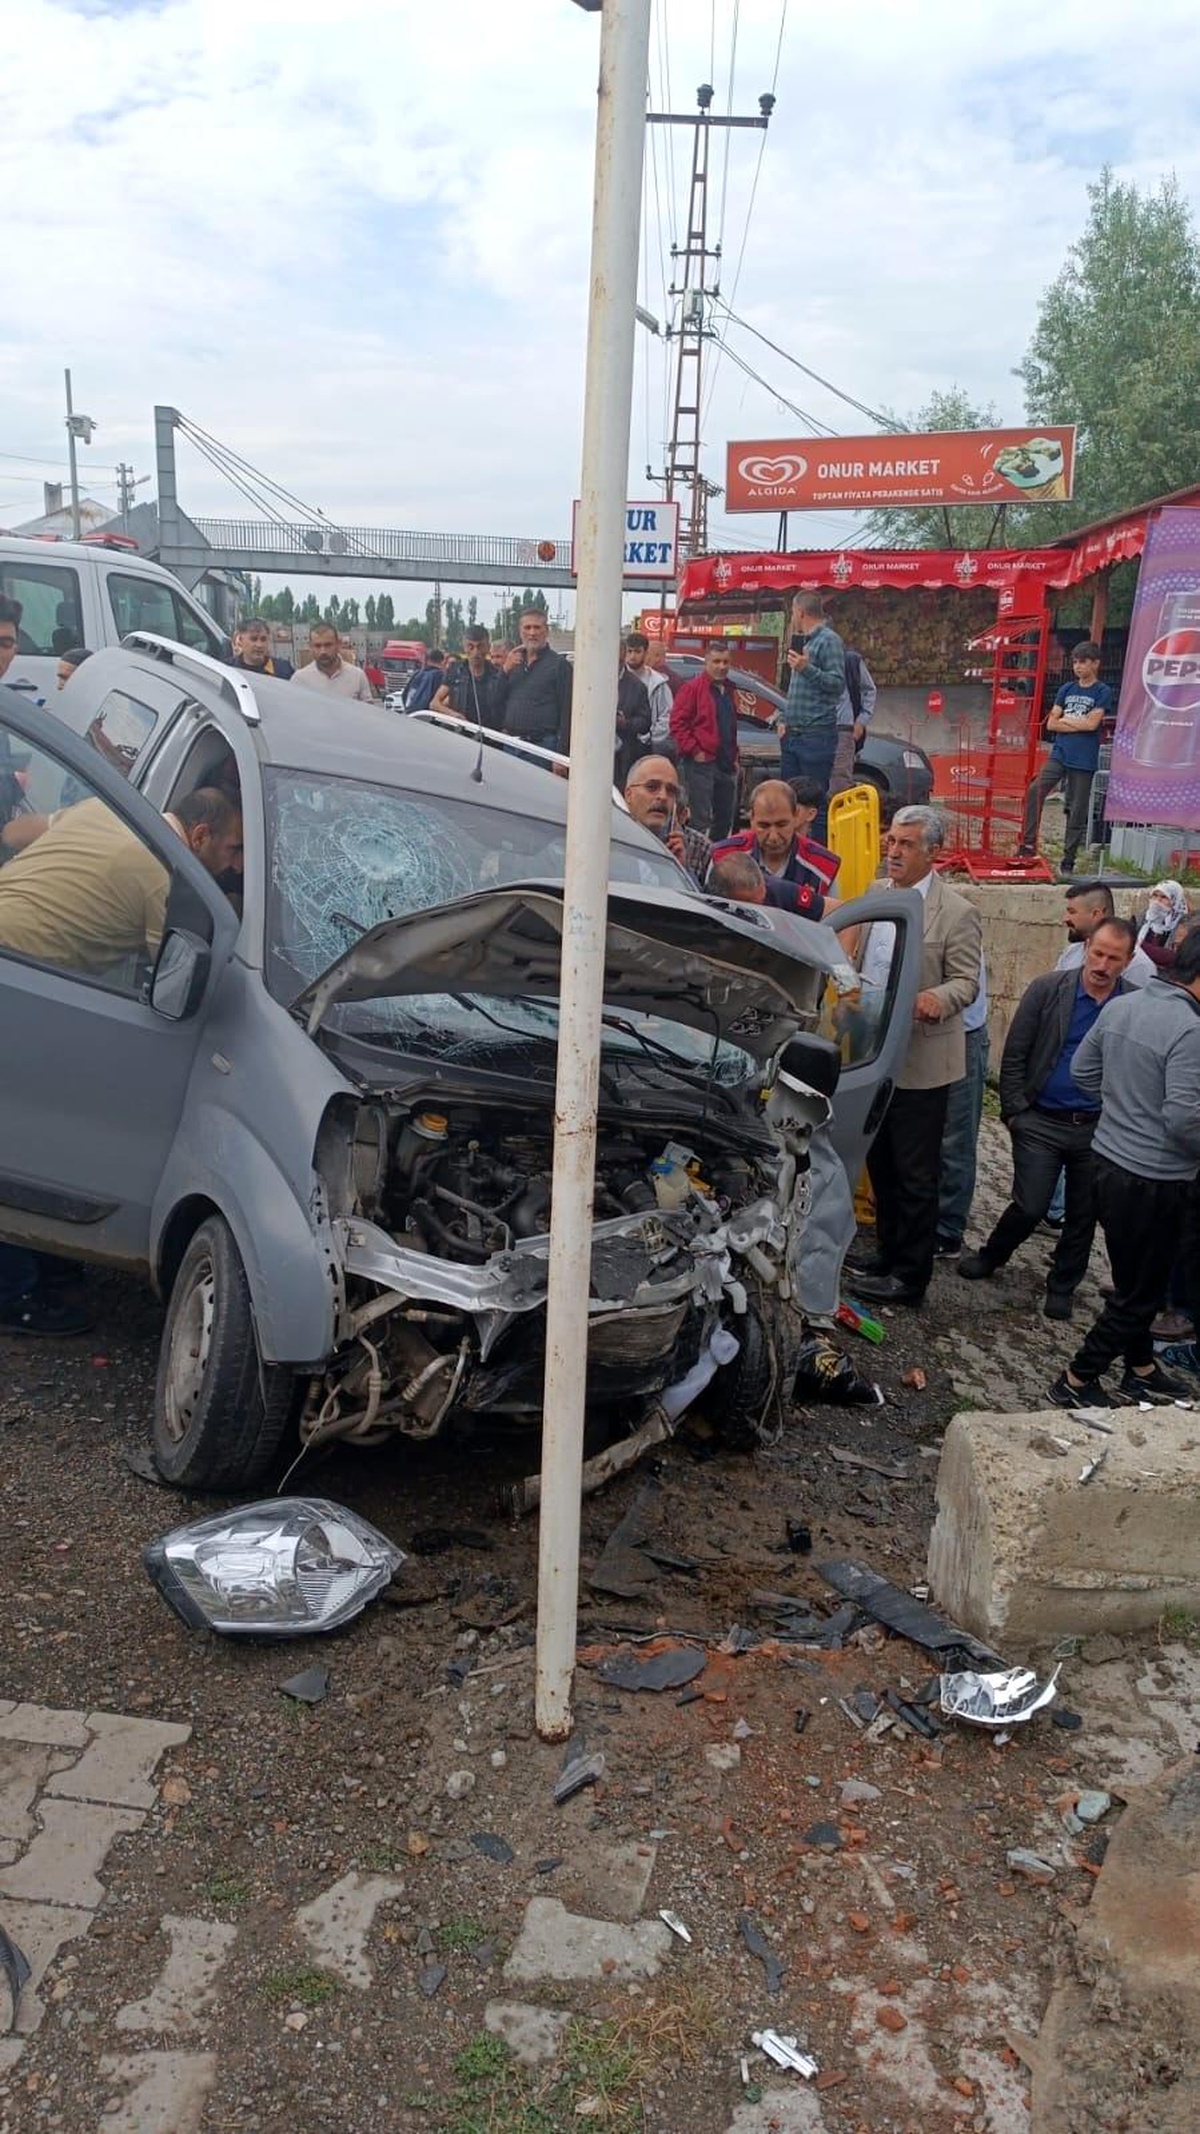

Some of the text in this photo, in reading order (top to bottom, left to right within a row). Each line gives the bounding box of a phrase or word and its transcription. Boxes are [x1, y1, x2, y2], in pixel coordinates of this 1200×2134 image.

[818, 459, 940, 479] ONUR MARKET
[747, 487, 796, 497] ALGIDA
[626, 509, 656, 531] UR
[623, 542, 672, 563] KET
[764, 564, 796, 572] MARKET
[886, 562, 919, 571] MARKET
[1012, 562, 1046, 570] MARKET
